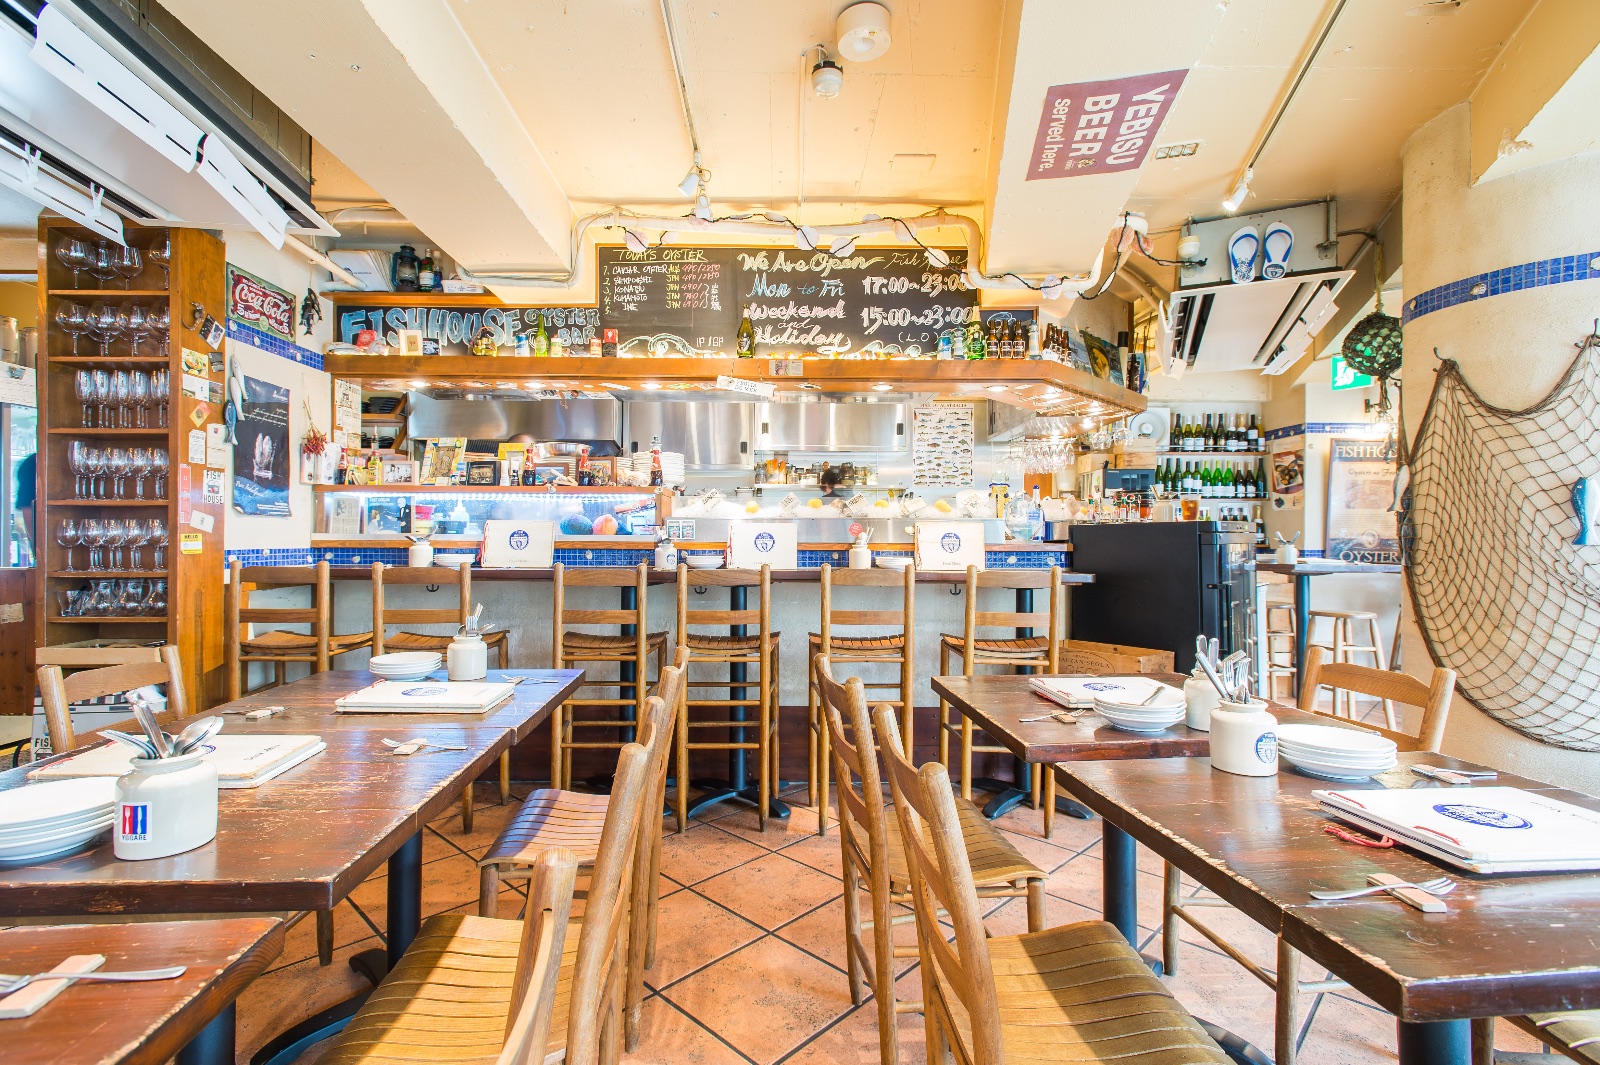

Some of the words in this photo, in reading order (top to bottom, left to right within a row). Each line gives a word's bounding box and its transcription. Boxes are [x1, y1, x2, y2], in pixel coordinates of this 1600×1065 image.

[1047, 98, 1072, 143] served
[1068, 93, 1121, 157] BEER
[1105, 83, 1171, 166] YEBISU
[1038, 142, 1064, 172] here.
[662, 248, 709, 262] OYSTER
[736, 251, 770, 272] We
[768, 250, 811, 273] Are
[809, 252, 885, 278] Open
[745, 271, 792, 298] Mon
[798, 279, 819, 295] to
[818, 278, 846, 298] Fri
[523, 308, 601, 328] OYSTER
[778, 318, 815, 329] and
[558, 326, 597, 348] BAR
[1336, 445, 1364, 458] FISH
[206, 470, 221, 480] FISH
[203, 494, 224, 505] HOUSE
[1339, 550, 1399, 563] OYSTER
[35, 737, 52, 748] FIS
